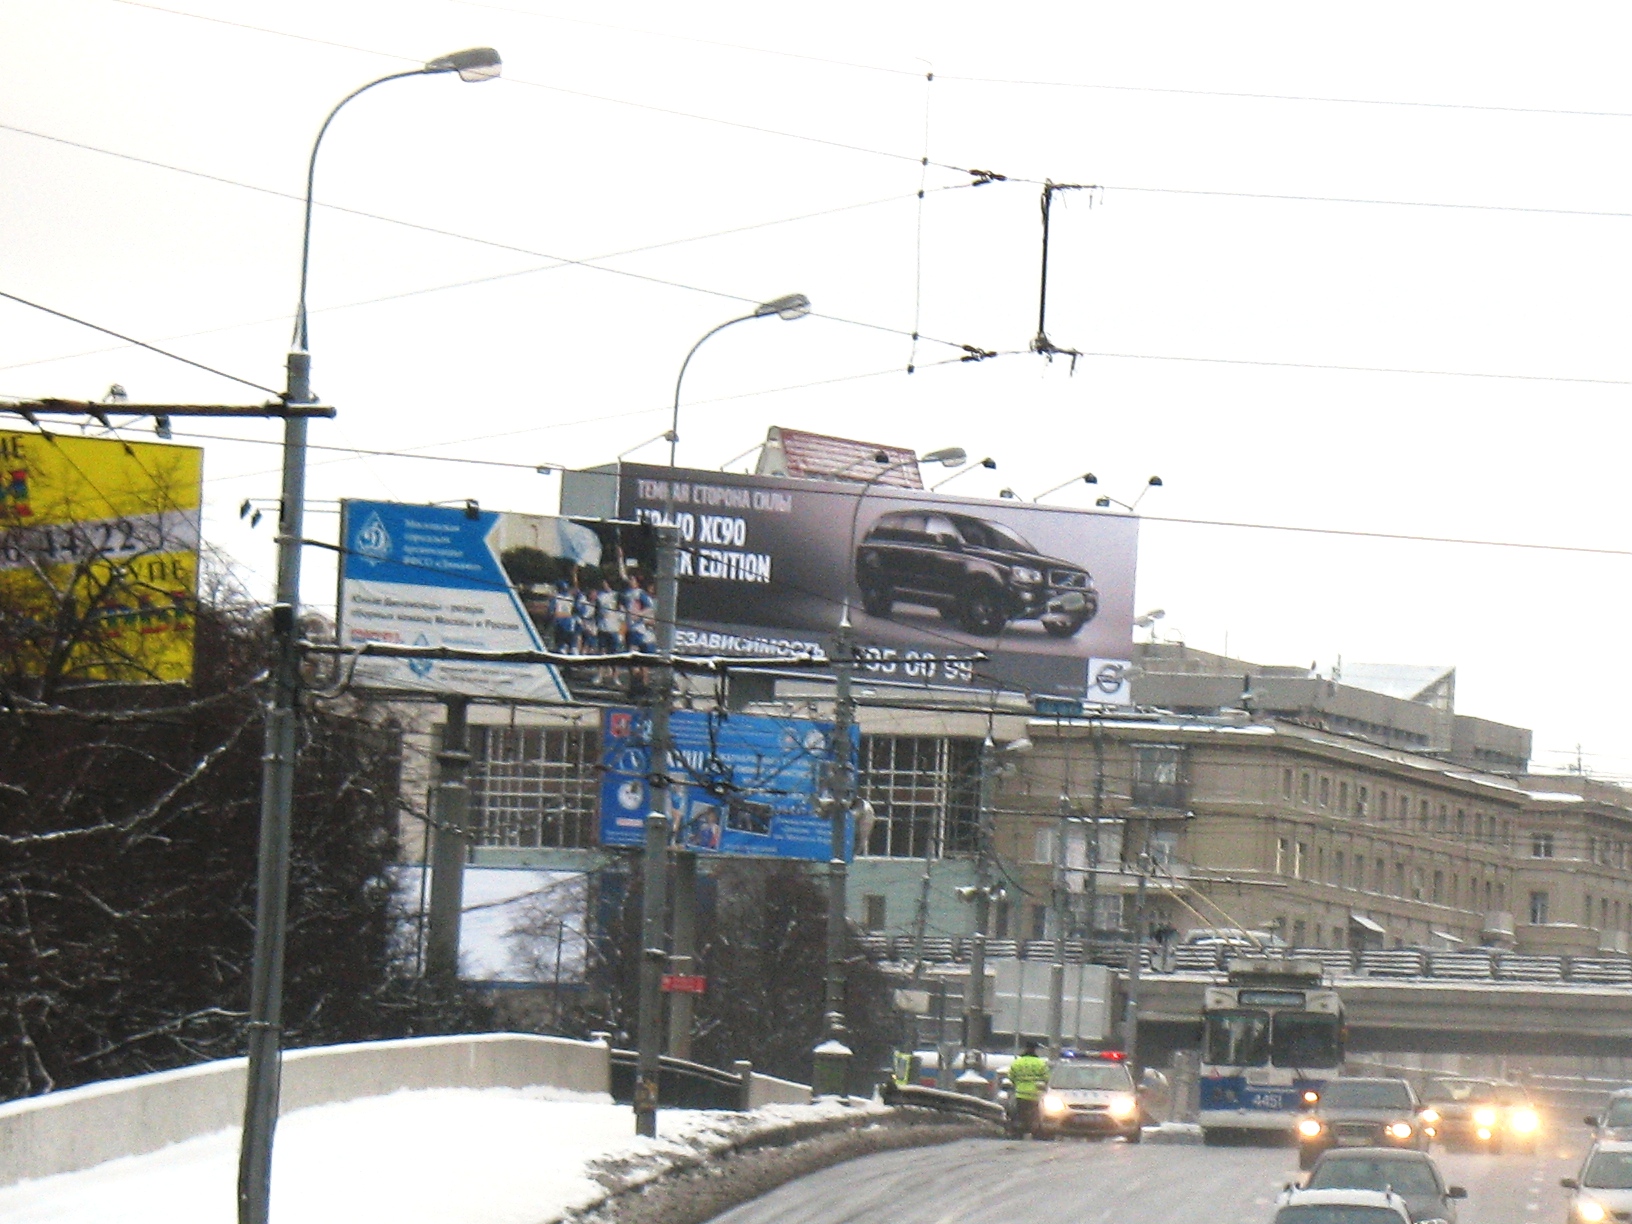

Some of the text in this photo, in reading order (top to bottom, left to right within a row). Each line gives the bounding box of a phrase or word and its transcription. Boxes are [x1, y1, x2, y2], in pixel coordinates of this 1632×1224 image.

[693, 484, 750, 508] СТОРОНА
[700, 514, 747, 547] XC90
[698, 549, 772, 583] EDITION
[674, 631, 825, 658] ЕЗАВИСИМОСТЬ
